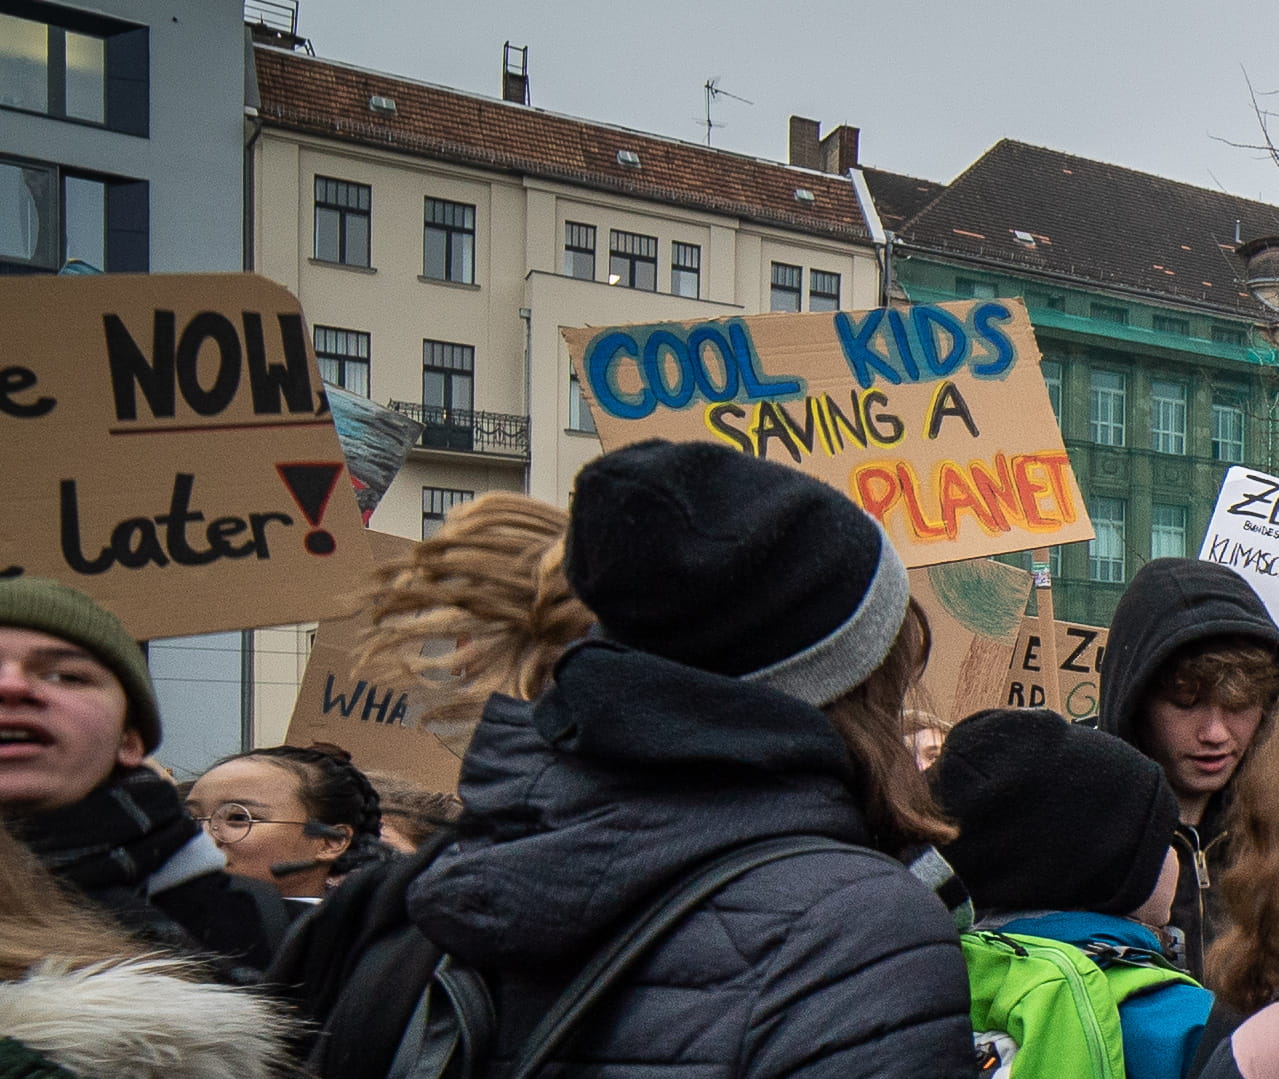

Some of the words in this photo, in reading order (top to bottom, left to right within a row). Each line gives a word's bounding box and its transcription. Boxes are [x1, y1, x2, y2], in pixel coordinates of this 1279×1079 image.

[584, 317, 803, 420] COOL
[832, 302, 1018, 390] KIDS
[704, 388, 906, 463] SAVING
[922, 380, 980, 440] A
[850, 447, 1078, 543] PLANET
